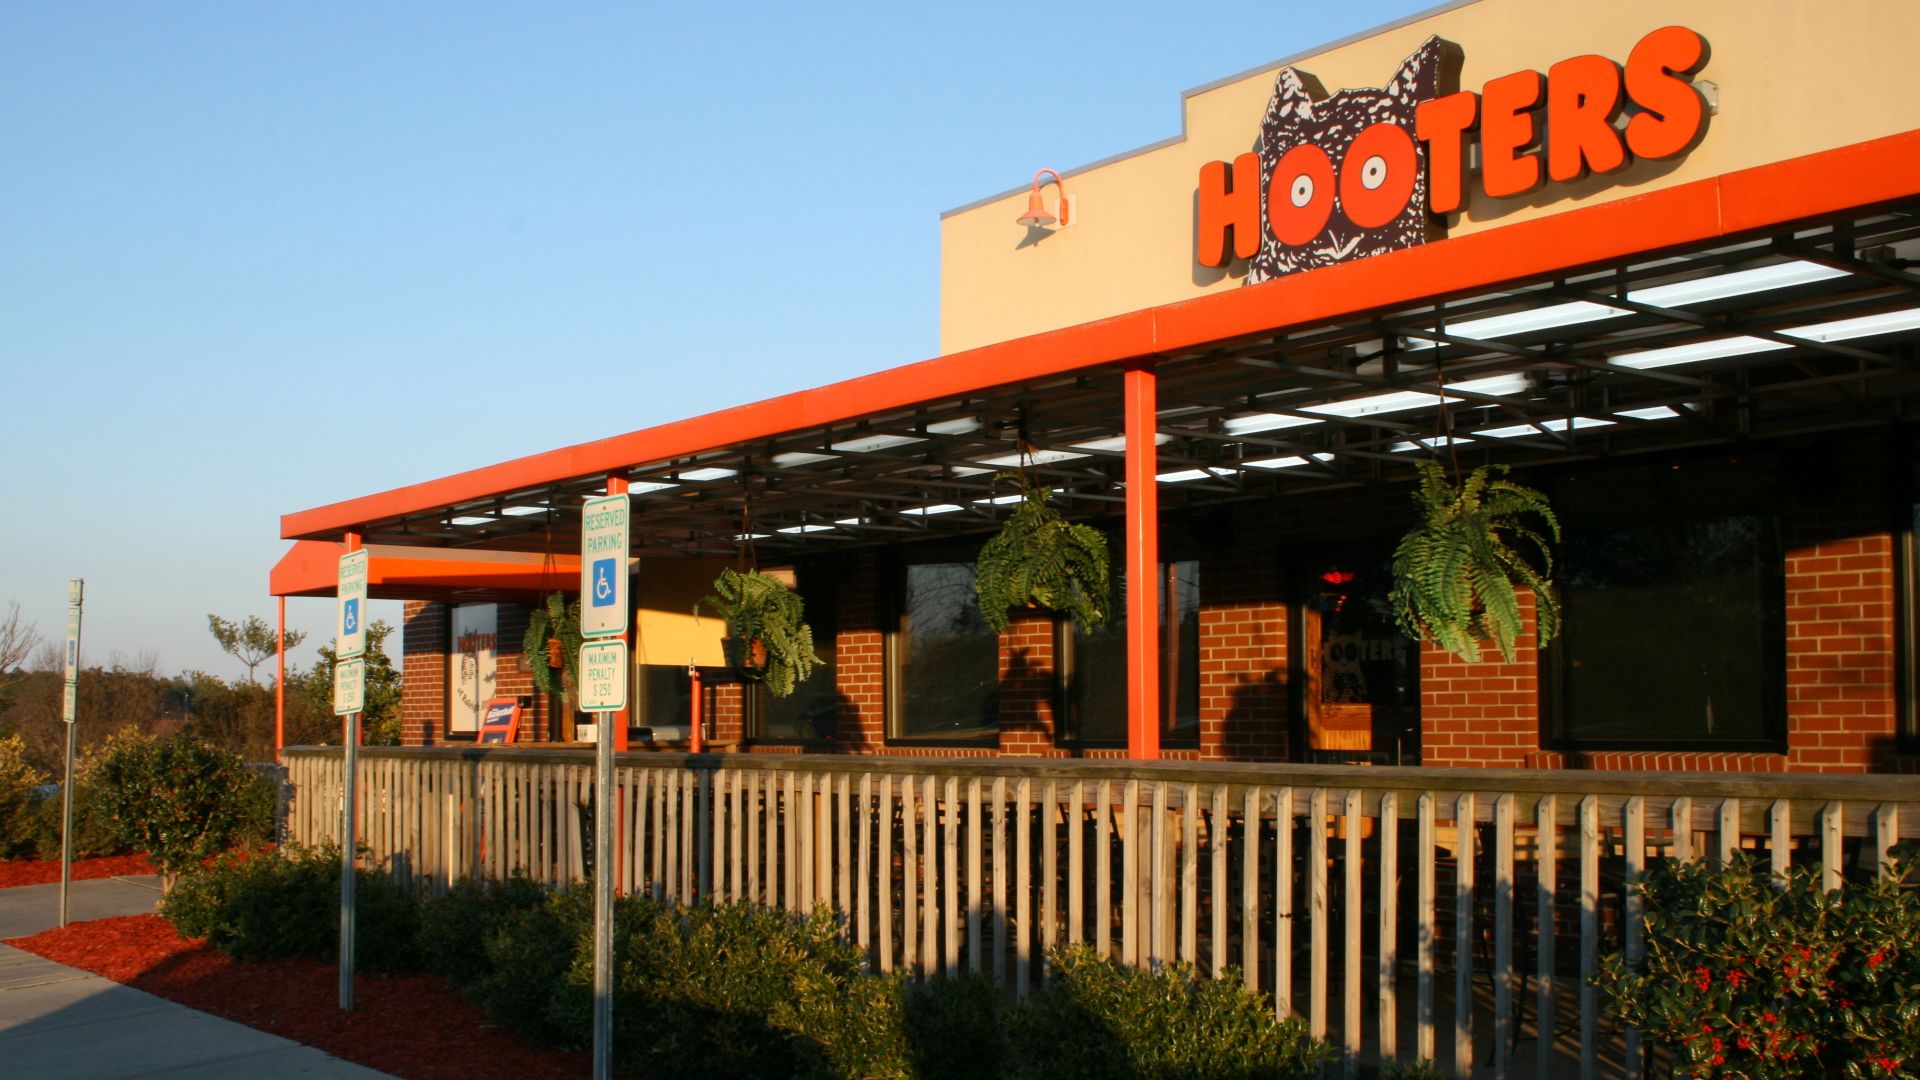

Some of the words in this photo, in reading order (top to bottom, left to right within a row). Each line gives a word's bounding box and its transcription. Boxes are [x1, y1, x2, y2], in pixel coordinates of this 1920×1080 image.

[1198, 25, 1701, 267] HOOTERS
[585, 509, 624, 530] RESERVED
[588, 533, 622, 553] PARKING
[340, 560, 365, 580] RESERVED
[341, 579, 363, 595] PARKING
[588, 652, 617, 665] MAXIMUM
[588, 667, 615, 681] PENALTY
